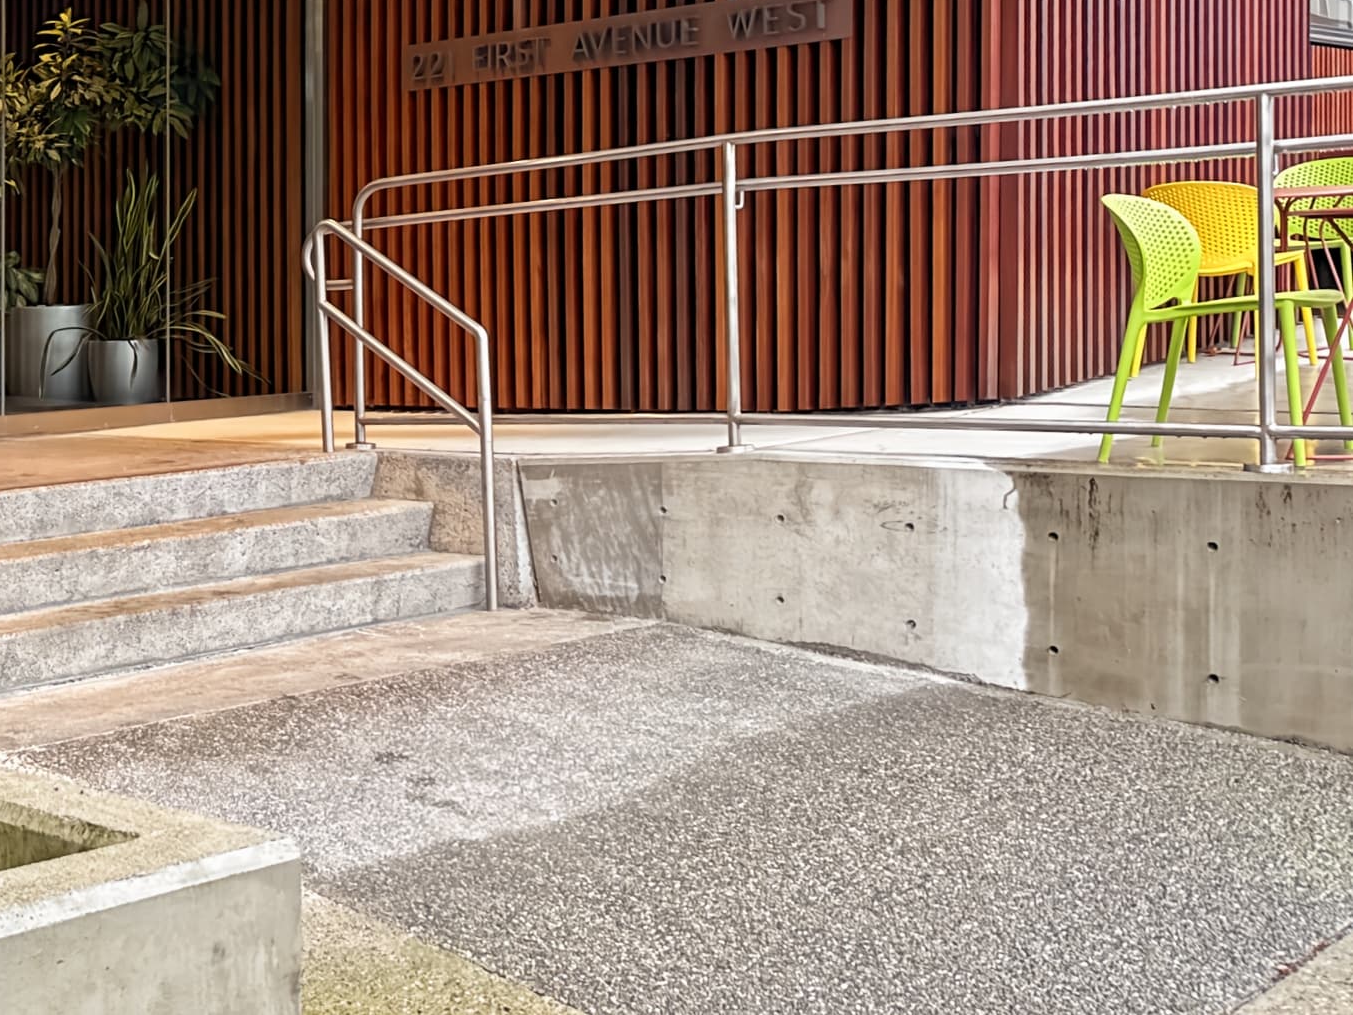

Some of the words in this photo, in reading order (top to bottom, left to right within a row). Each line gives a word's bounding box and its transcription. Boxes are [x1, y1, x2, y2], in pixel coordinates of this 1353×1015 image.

[413, 51, 455, 82] 221
[472, 37, 552, 73] FIRST
[571, 15, 700, 61] AVENUE
